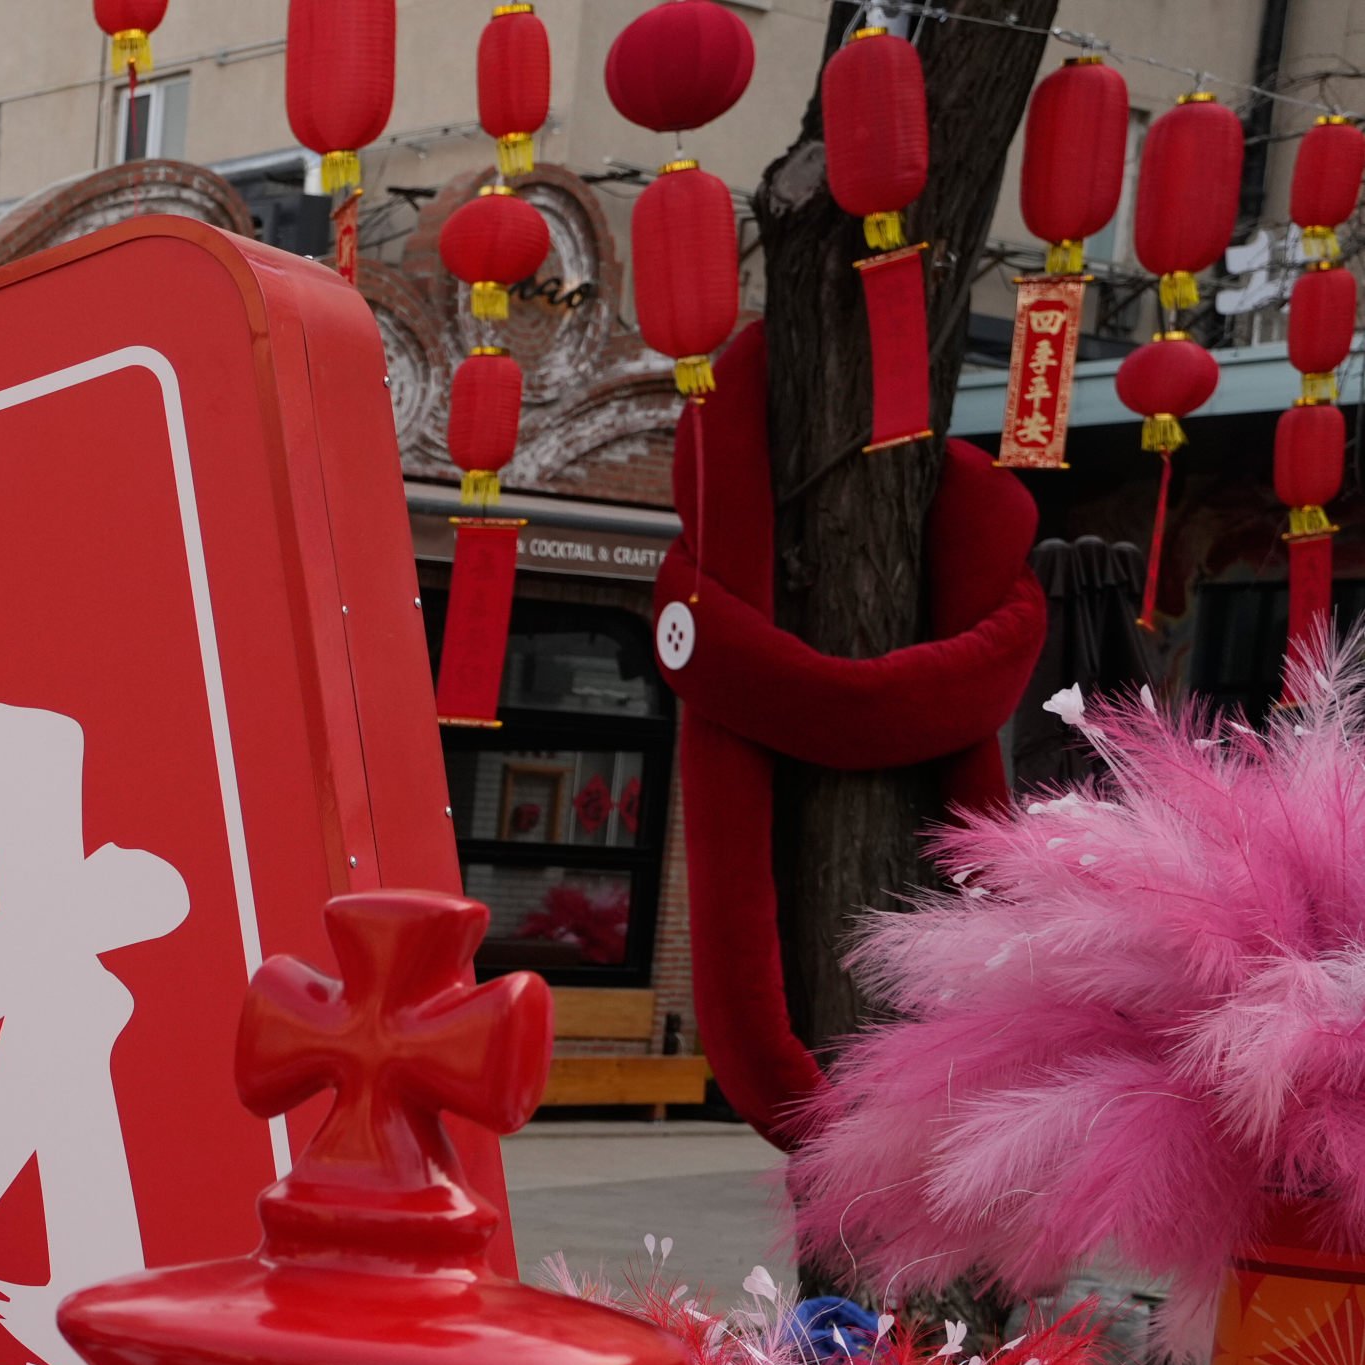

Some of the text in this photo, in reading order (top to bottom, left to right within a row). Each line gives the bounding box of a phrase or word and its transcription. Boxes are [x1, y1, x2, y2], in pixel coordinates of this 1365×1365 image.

[1016, 309, 1067, 446] 四季平安
[529, 538, 595, 562] COCKTAIL
[598, 546, 610, 562] &
[613, 546, 658, 567] CRAFT
